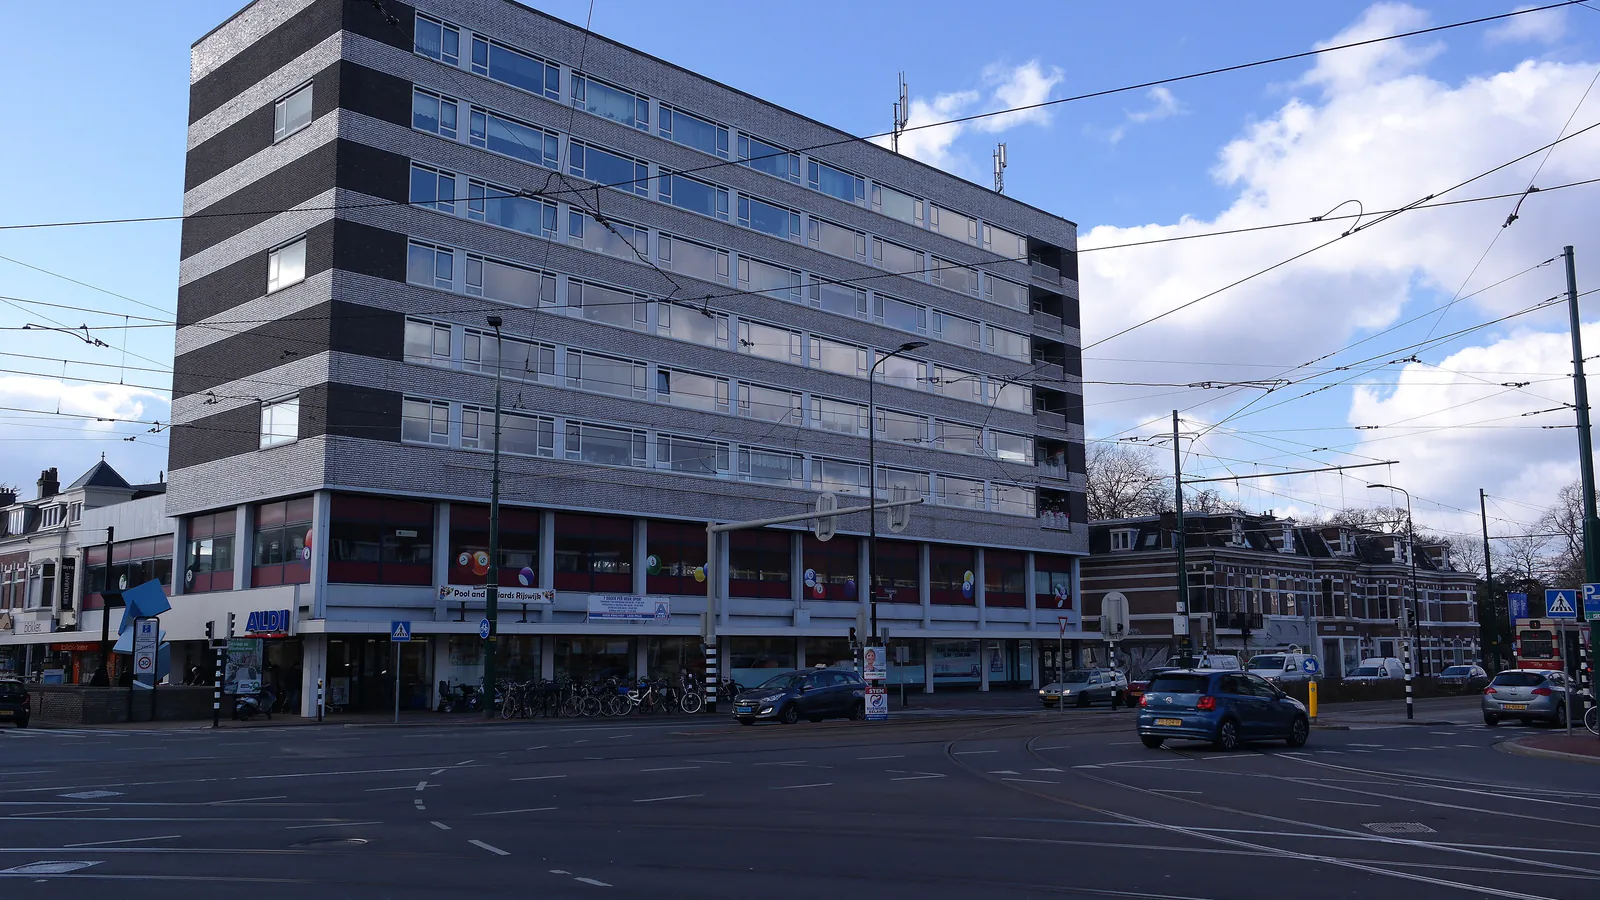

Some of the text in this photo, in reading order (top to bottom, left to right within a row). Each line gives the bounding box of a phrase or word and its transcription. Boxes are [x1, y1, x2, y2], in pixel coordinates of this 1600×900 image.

[62, 572, 70, 605] RESTAURANT
[454, 589, 470, 598] Pool
[471, 590, 486, 598] and
[515, 592, 542, 601] Rijswijk
[1584, 585, 1595, 600] P
[245, 609, 290, 632] ALDI
